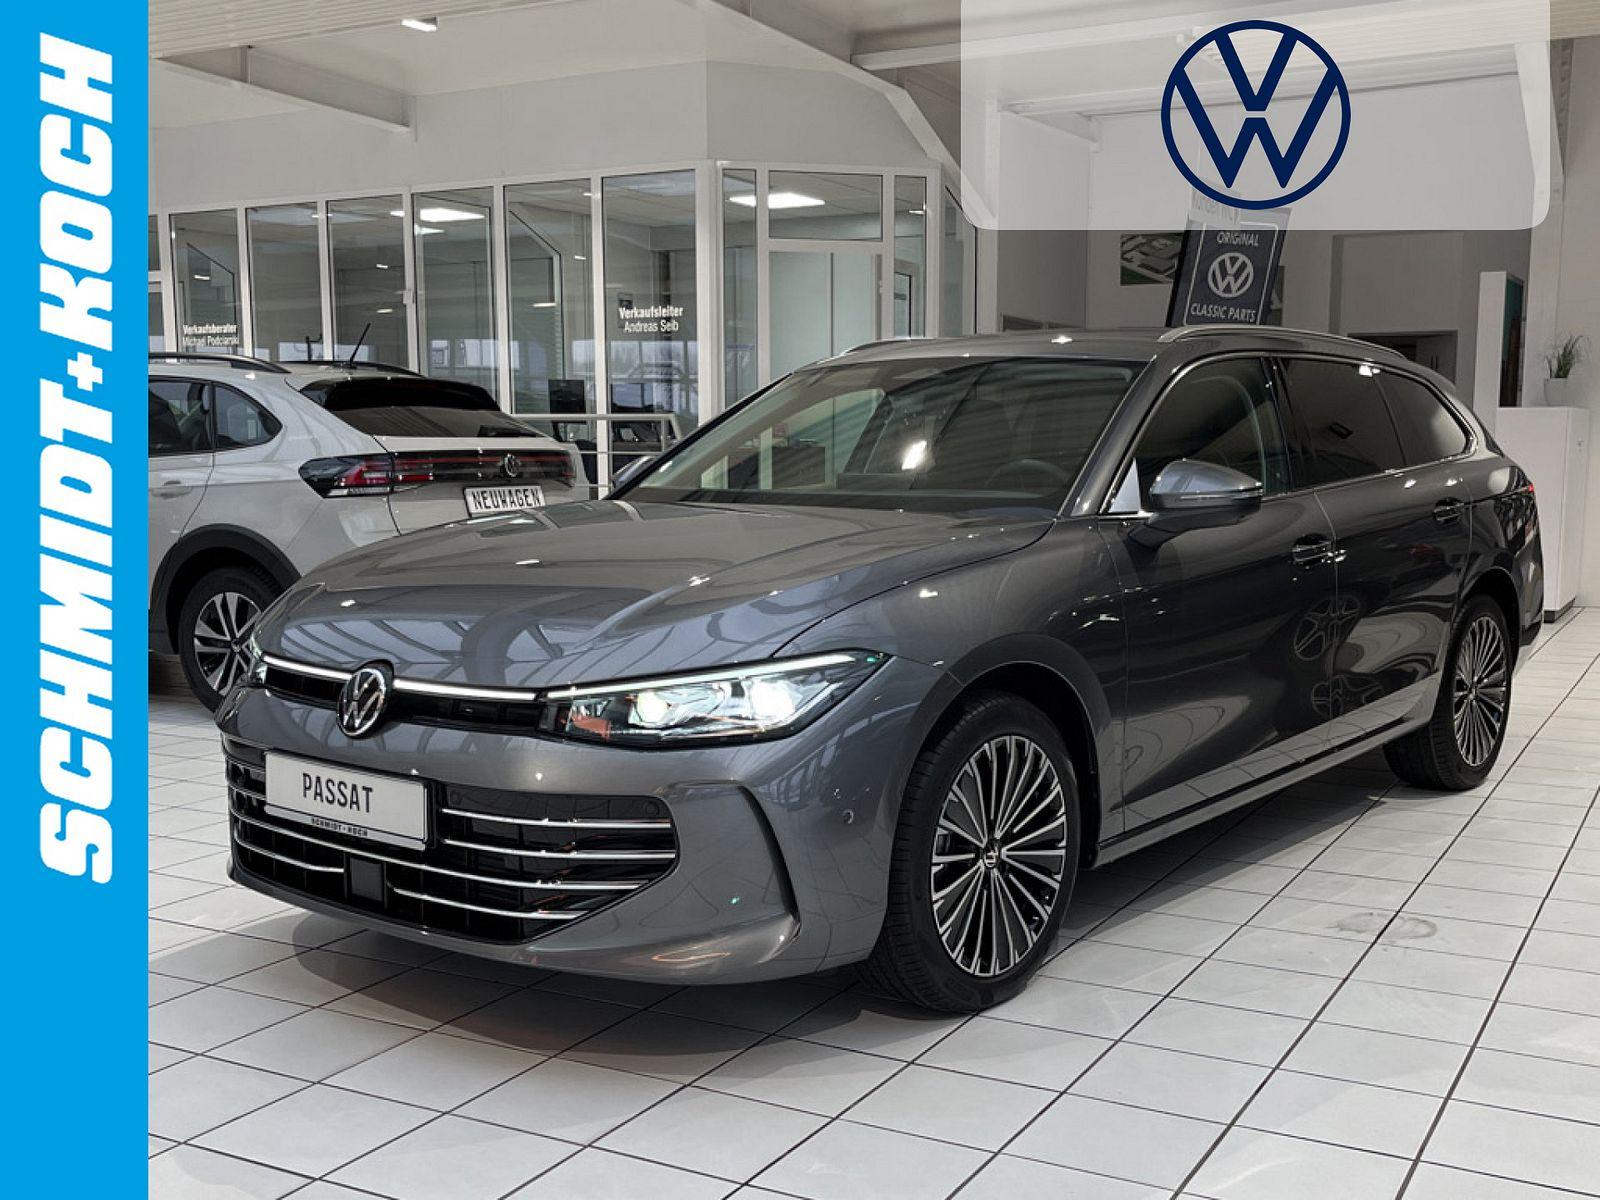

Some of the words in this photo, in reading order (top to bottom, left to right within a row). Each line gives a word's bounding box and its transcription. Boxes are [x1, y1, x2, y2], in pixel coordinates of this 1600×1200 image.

[1217, 231, 1259, 246] ORIGINAL
[618, 306, 684, 319] Verkaufsleiter
[1190, 303, 1227, 319] CLASSIC
[1228, 307, 1257, 322] PARTS
[182, 323, 237, 335] Verkaufsberater
[624, 321, 659, 333] Andreas
[472, 489, 542, 509] NEUWAGEN
[302, 772, 373, 813] PASSAT
